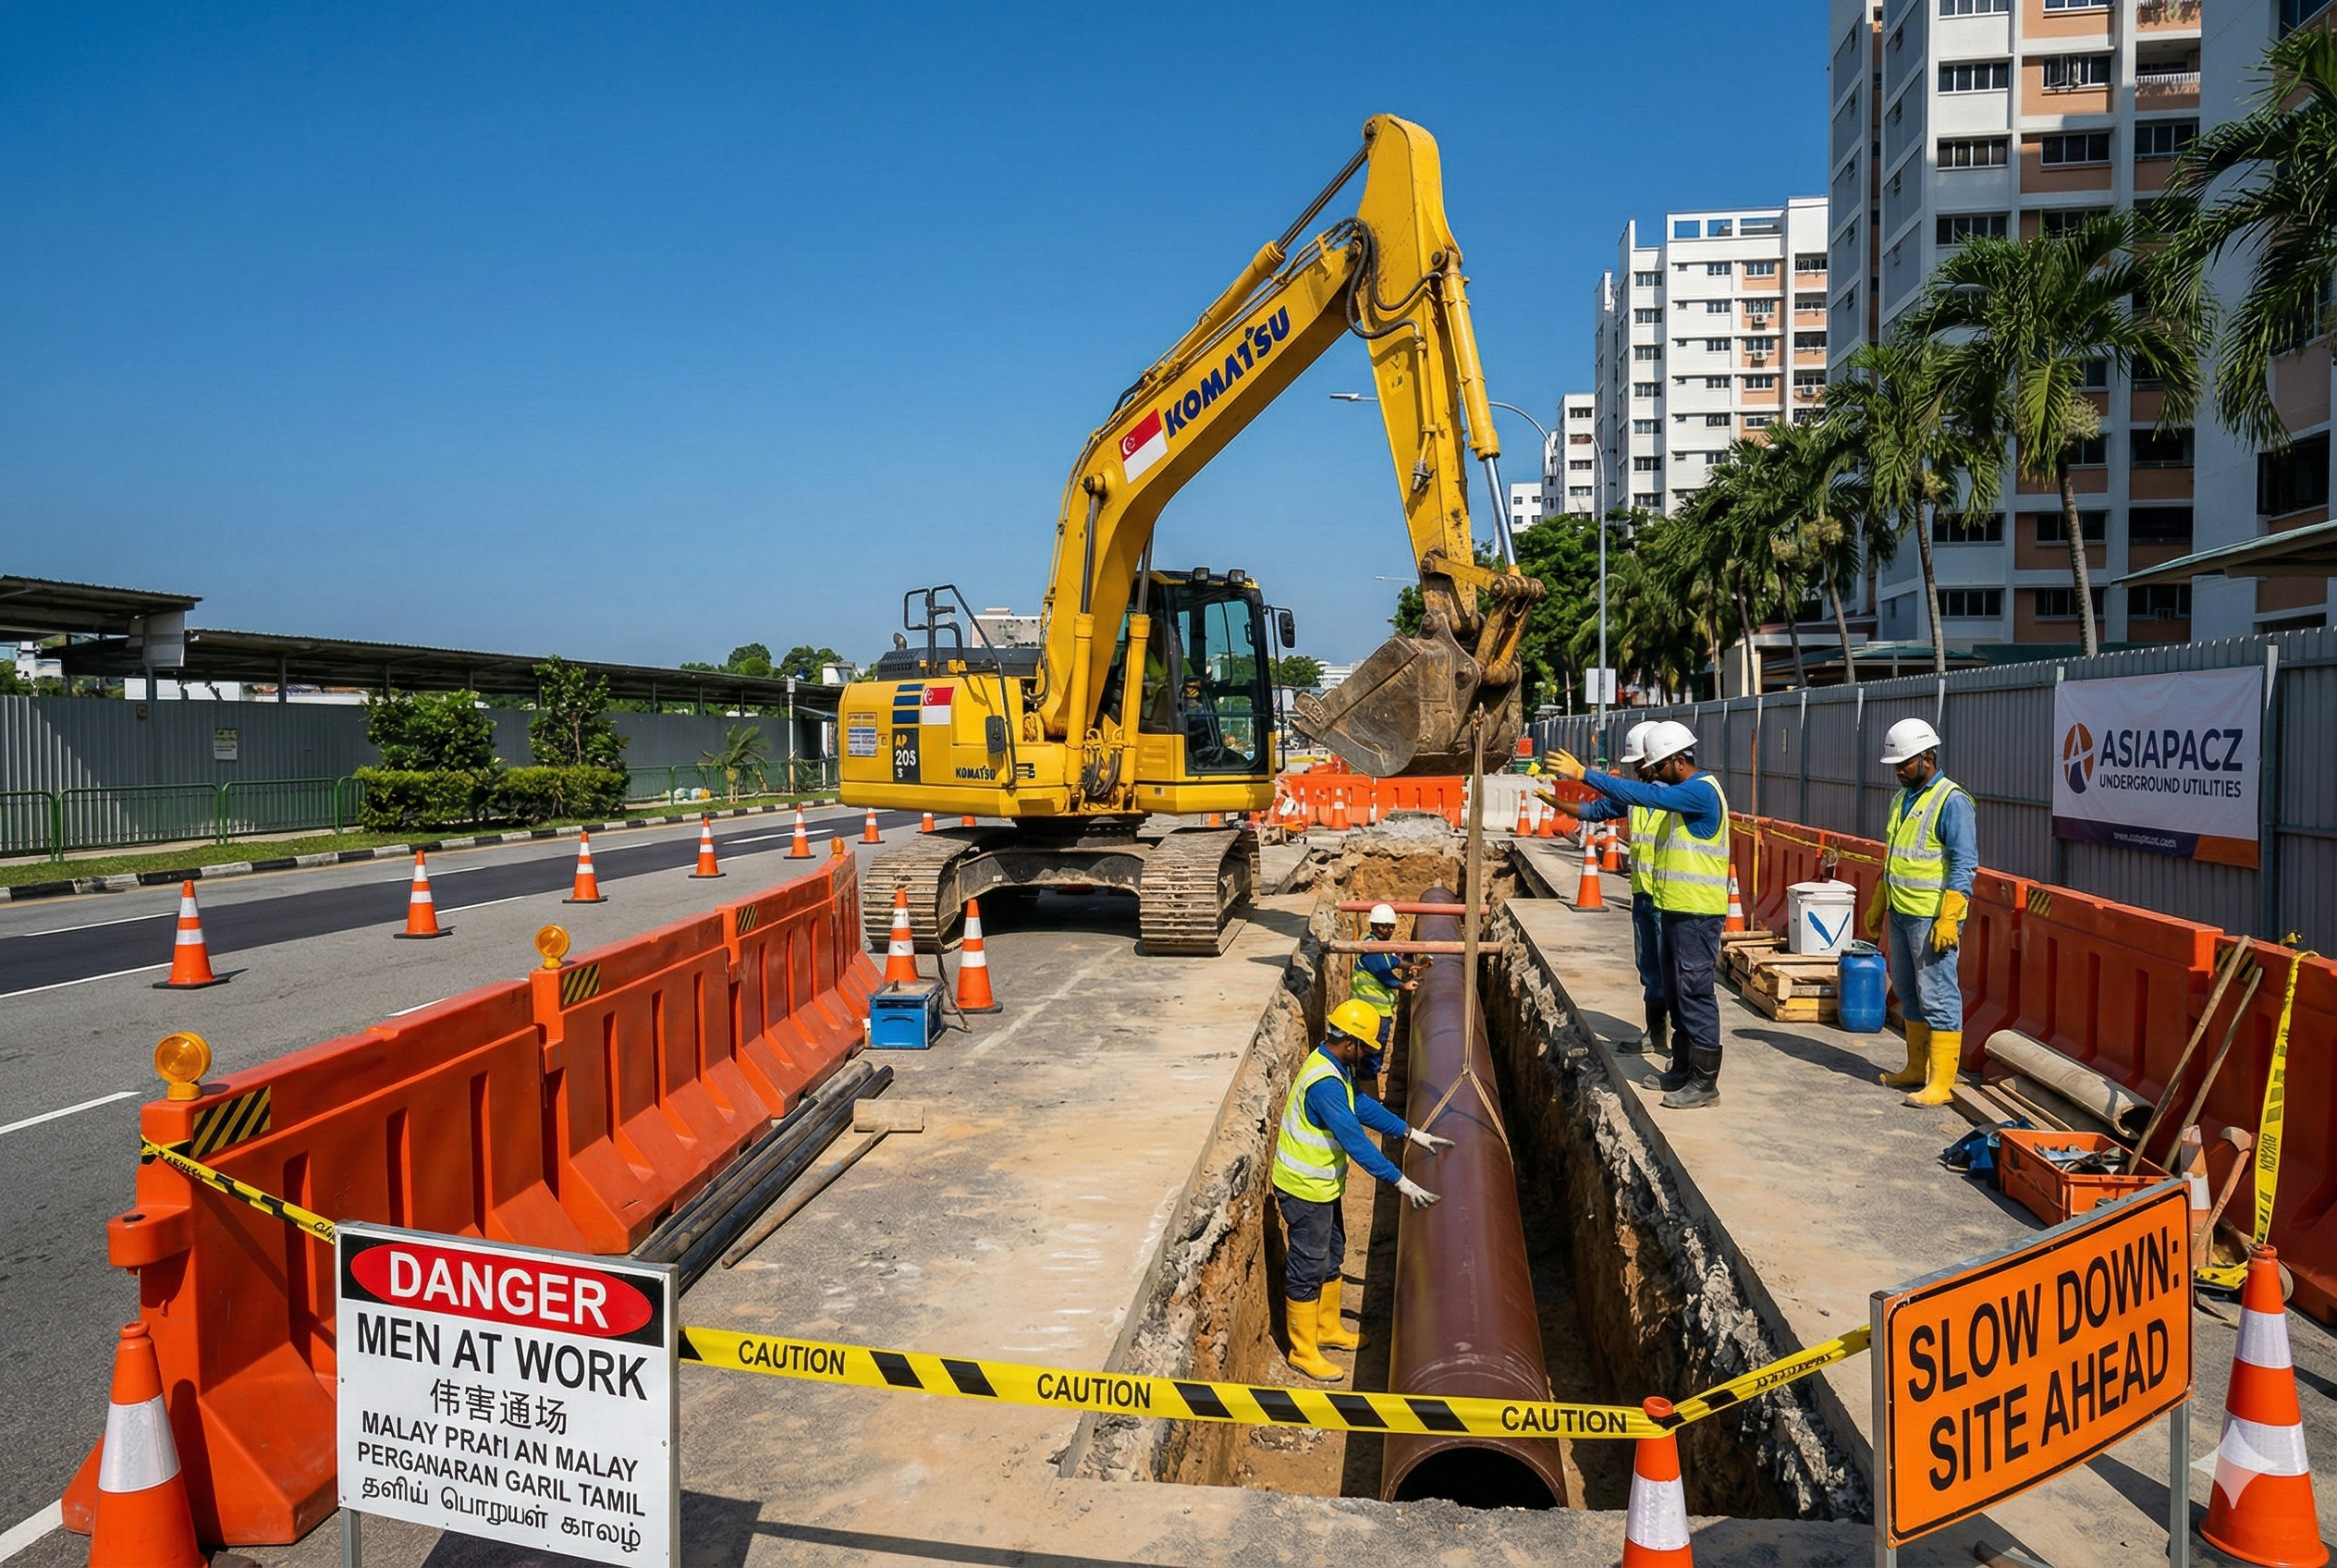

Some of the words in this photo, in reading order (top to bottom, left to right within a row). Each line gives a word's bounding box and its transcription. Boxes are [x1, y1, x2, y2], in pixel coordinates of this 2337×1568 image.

[1164, 305, 1291, 439] KOMATSU
[895, 733, 908, 747] AP
[2098, 728, 2244, 772] ASIAPACZ
[955, 765, 997, 781] KOMATSU
[2098, 773, 2180, 794] UNDERGROUND
[2183, 778, 2242, 799] UTILITIES
[389, 1250, 610, 1329] DANGER
[1908, 1282, 2041, 1403] SLOW
[2056, 1226, 2179, 1344] DOWN:
[357, 1311, 440, 1366] MEN
[452, 1328, 502, 1374] AT
[514, 1335, 649, 1402] WORK
[738, 1339, 846, 1376] CAUTION
[430, 1378, 568, 1436] 伟害通场
[1036, 1373, 1151, 1409] CAUTION
[1500, 1405, 1628, 1434] CAUTION
[1928, 1383, 2029, 1492] SITE
[2040, 1317, 2170, 1448] AHEAD
[361, 1410, 439, 1446] MALAY
[514, 1439, 547, 1467] AN
[556, 1446, 639, 1483] MALAY
[357, 1440, 498, 1488] PERGANARAN
[505, 1469, 571, 1503] GARIL
[578, 1482, 646, 1517] TAMIL
